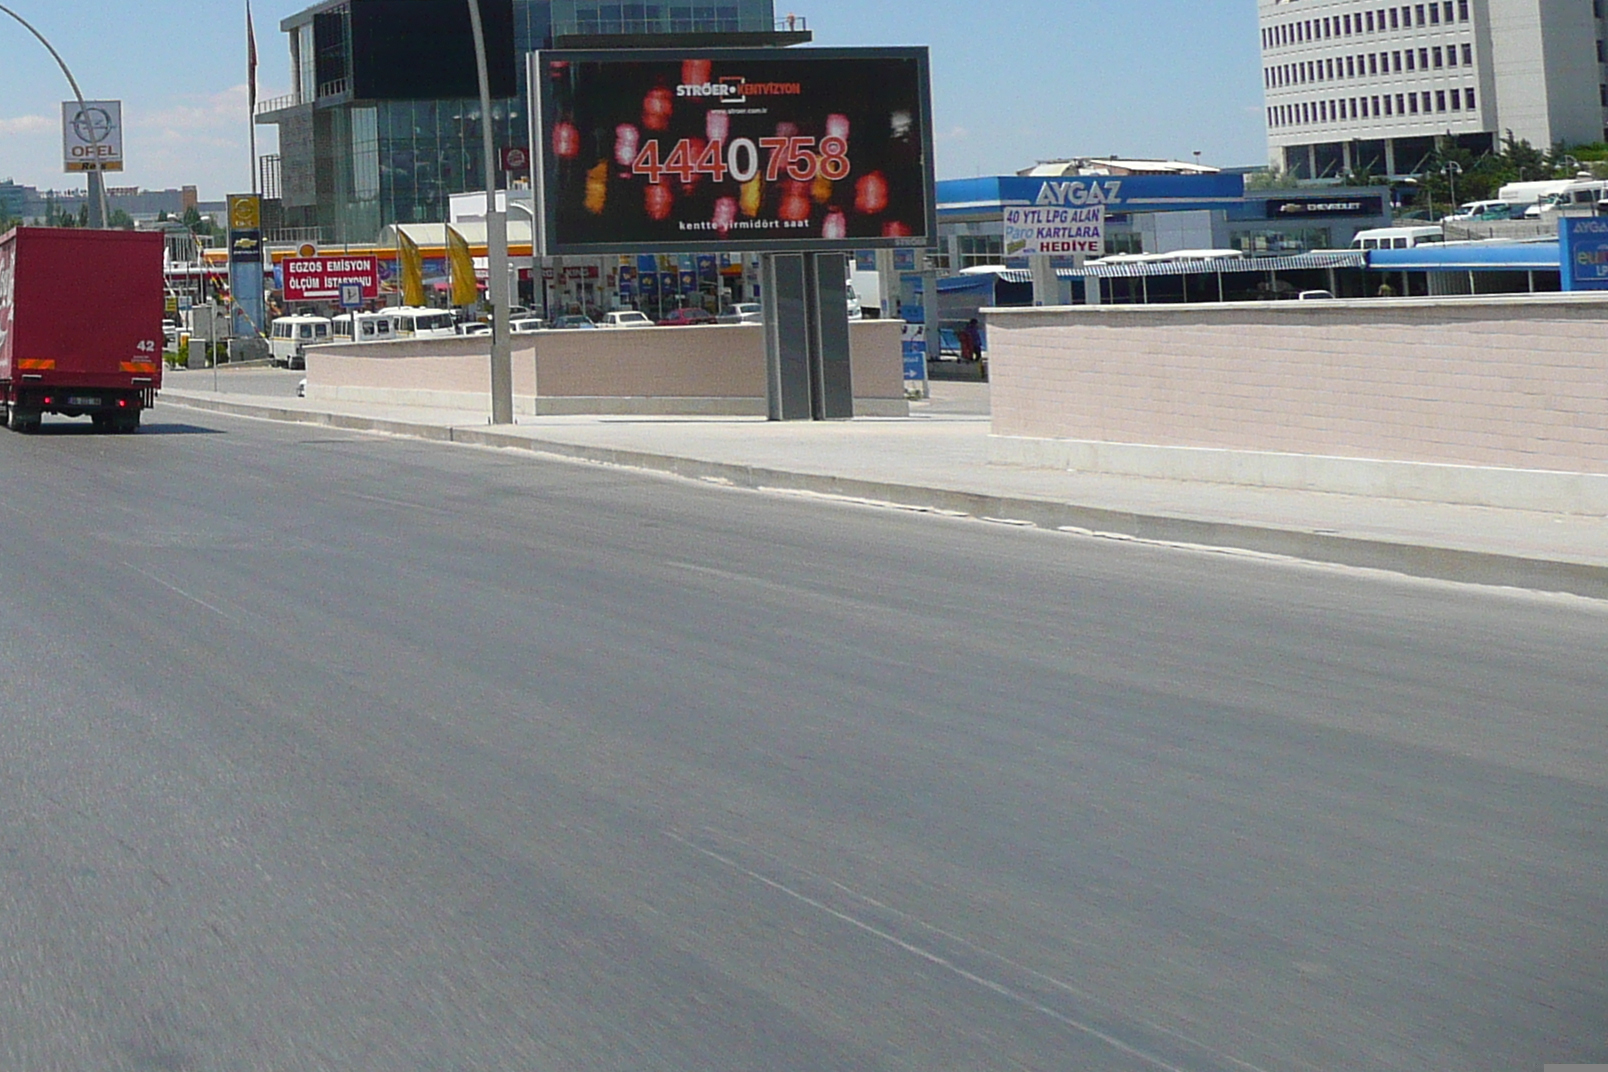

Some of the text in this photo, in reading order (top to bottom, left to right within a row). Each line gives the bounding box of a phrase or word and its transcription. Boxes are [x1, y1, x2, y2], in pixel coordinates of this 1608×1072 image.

[72, 145, 118, 156] OPEL
[1035, 180, 1122, 205] AYGAZ
[1006, 208, 1100, 224] 40 YTL LPG ALAN
[784, 219, 809, 228] saat
[1005, 226, 1101, 240] Paro KARTLARA
[1039, 240, 1099, 253] HEDİYE
[289, 259, 371, 272] EGZOS EMİSYON
[289, 276, 320, 290] ÖLÇÜM
[137, 339, 155, 352] 42
